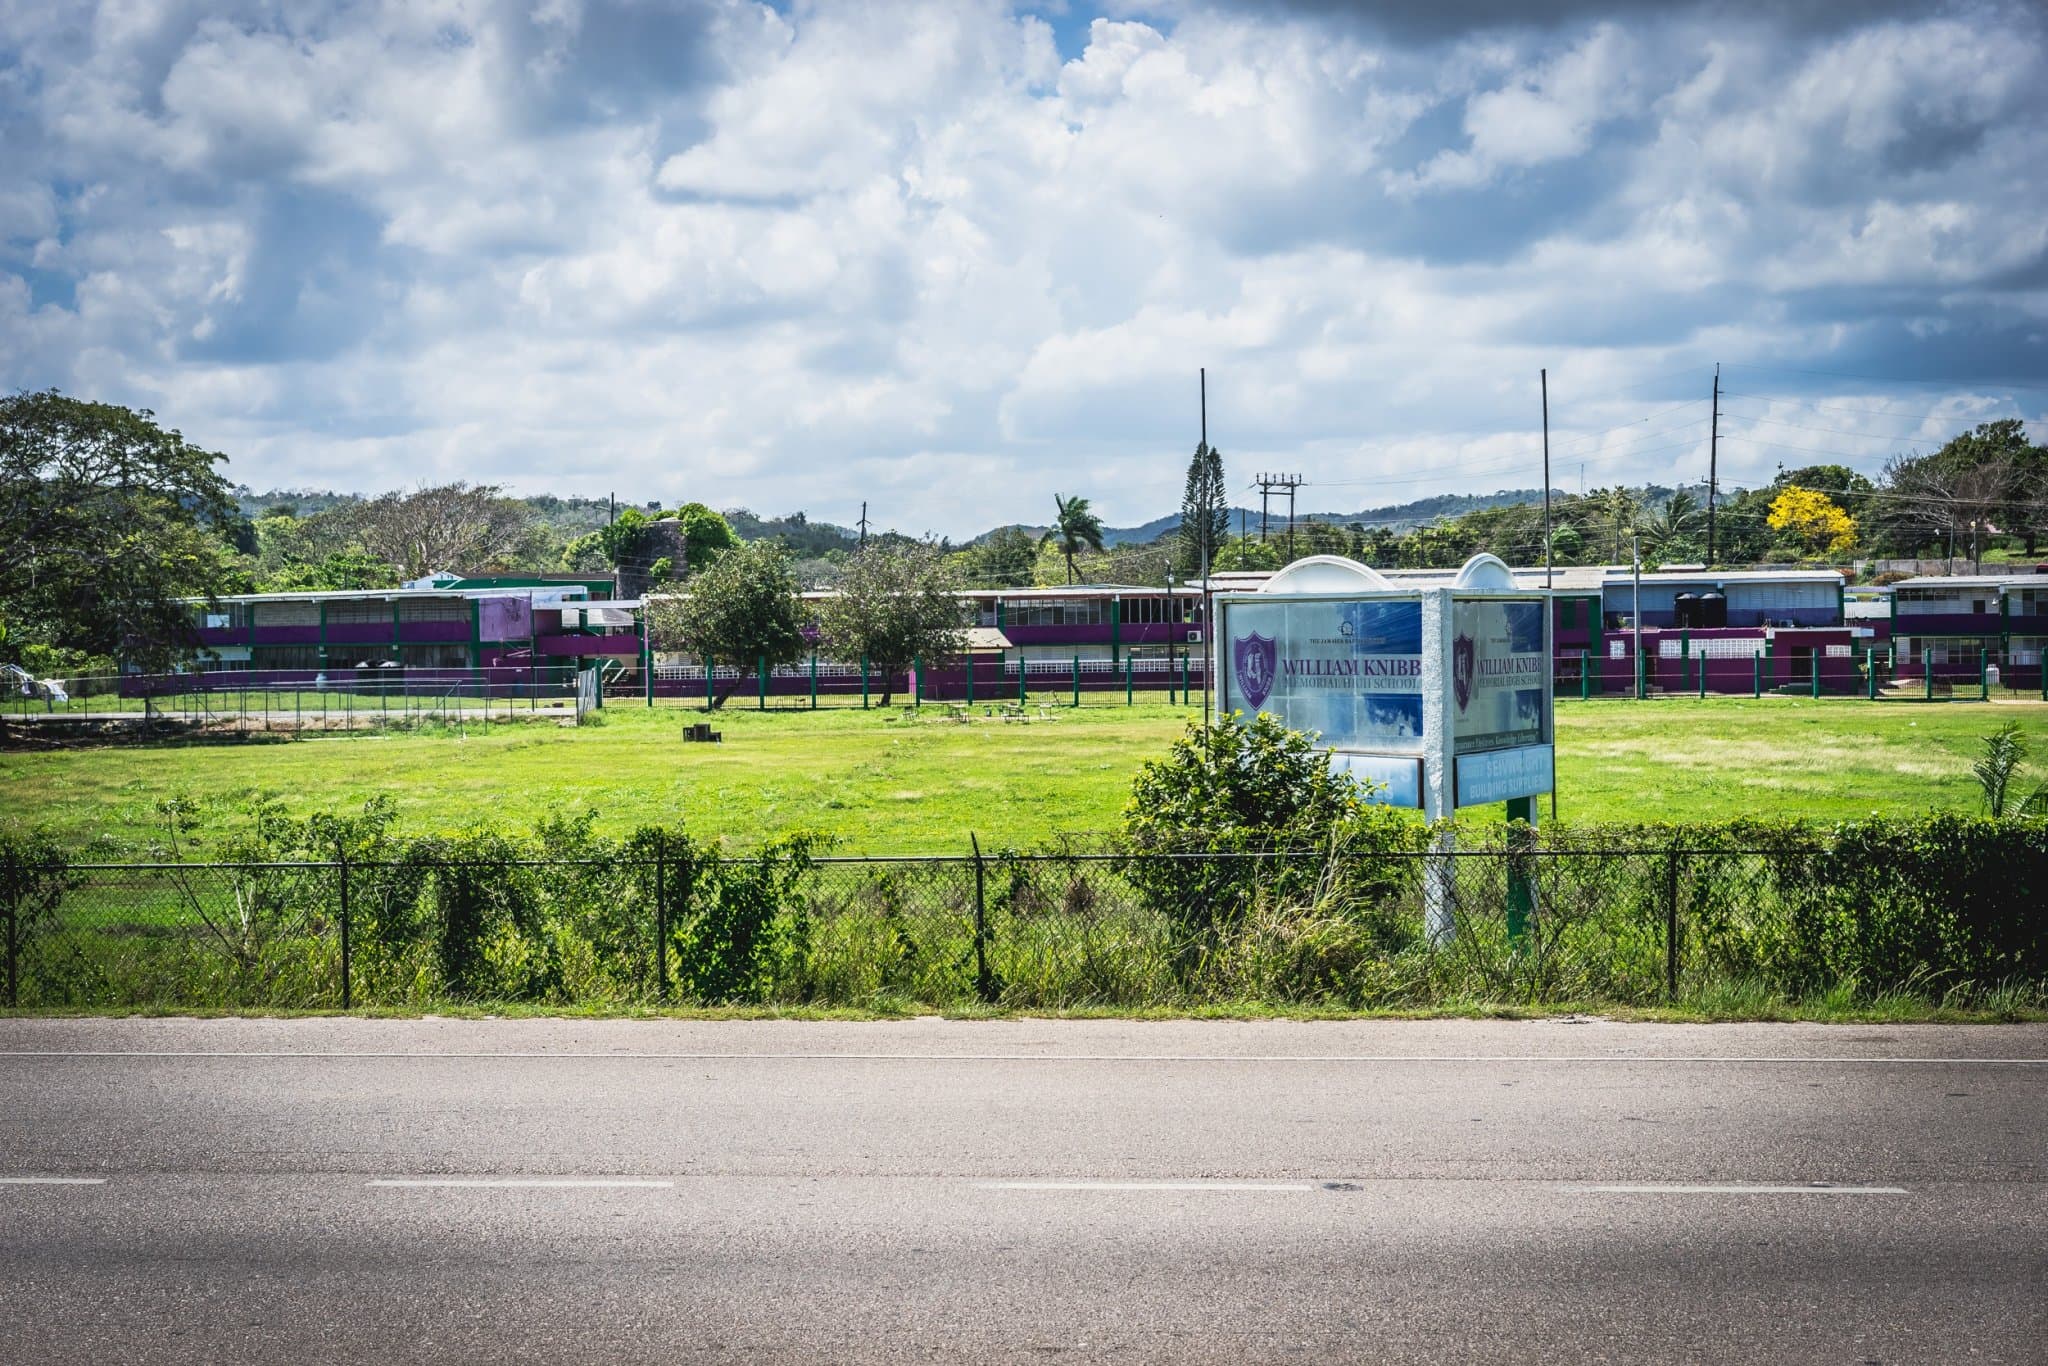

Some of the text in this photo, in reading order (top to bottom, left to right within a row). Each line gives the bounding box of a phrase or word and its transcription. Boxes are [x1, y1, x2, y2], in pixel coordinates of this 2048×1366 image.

[1282, 659, 1422, 676] WILLIAM KNIBB
[1477, 658, 1514, 676] WILLIAM
[1284, 678, 1339, 688] MEMORIAL
[1343, 677, 1371, 688] HIGH
[1373, 677, 1419, 689] SCHOOL
[1469, 775, 1544, 799] BUILDING SUPPLIES
